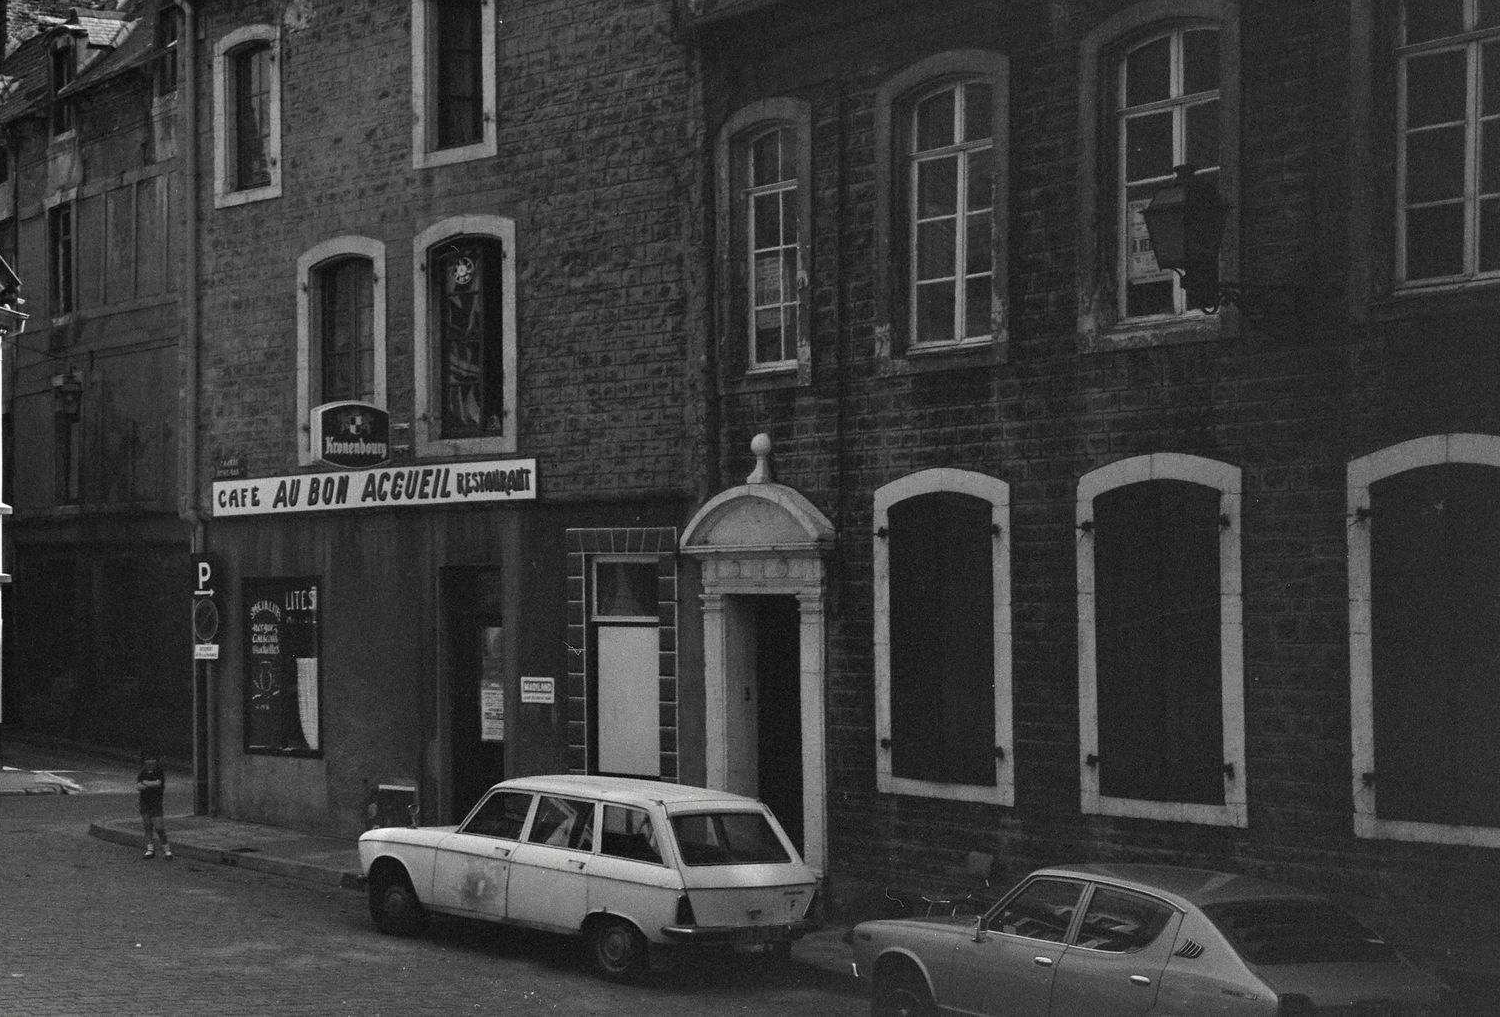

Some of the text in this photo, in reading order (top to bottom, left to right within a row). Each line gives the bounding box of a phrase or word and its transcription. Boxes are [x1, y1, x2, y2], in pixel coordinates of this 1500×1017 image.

[324, 436, 387, 459] Kronenbourg
[272, 478, 299, 508] AU
[307, 473, 350, 506] BON
[361, 467, 452, 503] ACCUEIL
[456, 467, 532, 498] RESTAURANT
[198, 562, 211, 589] P
